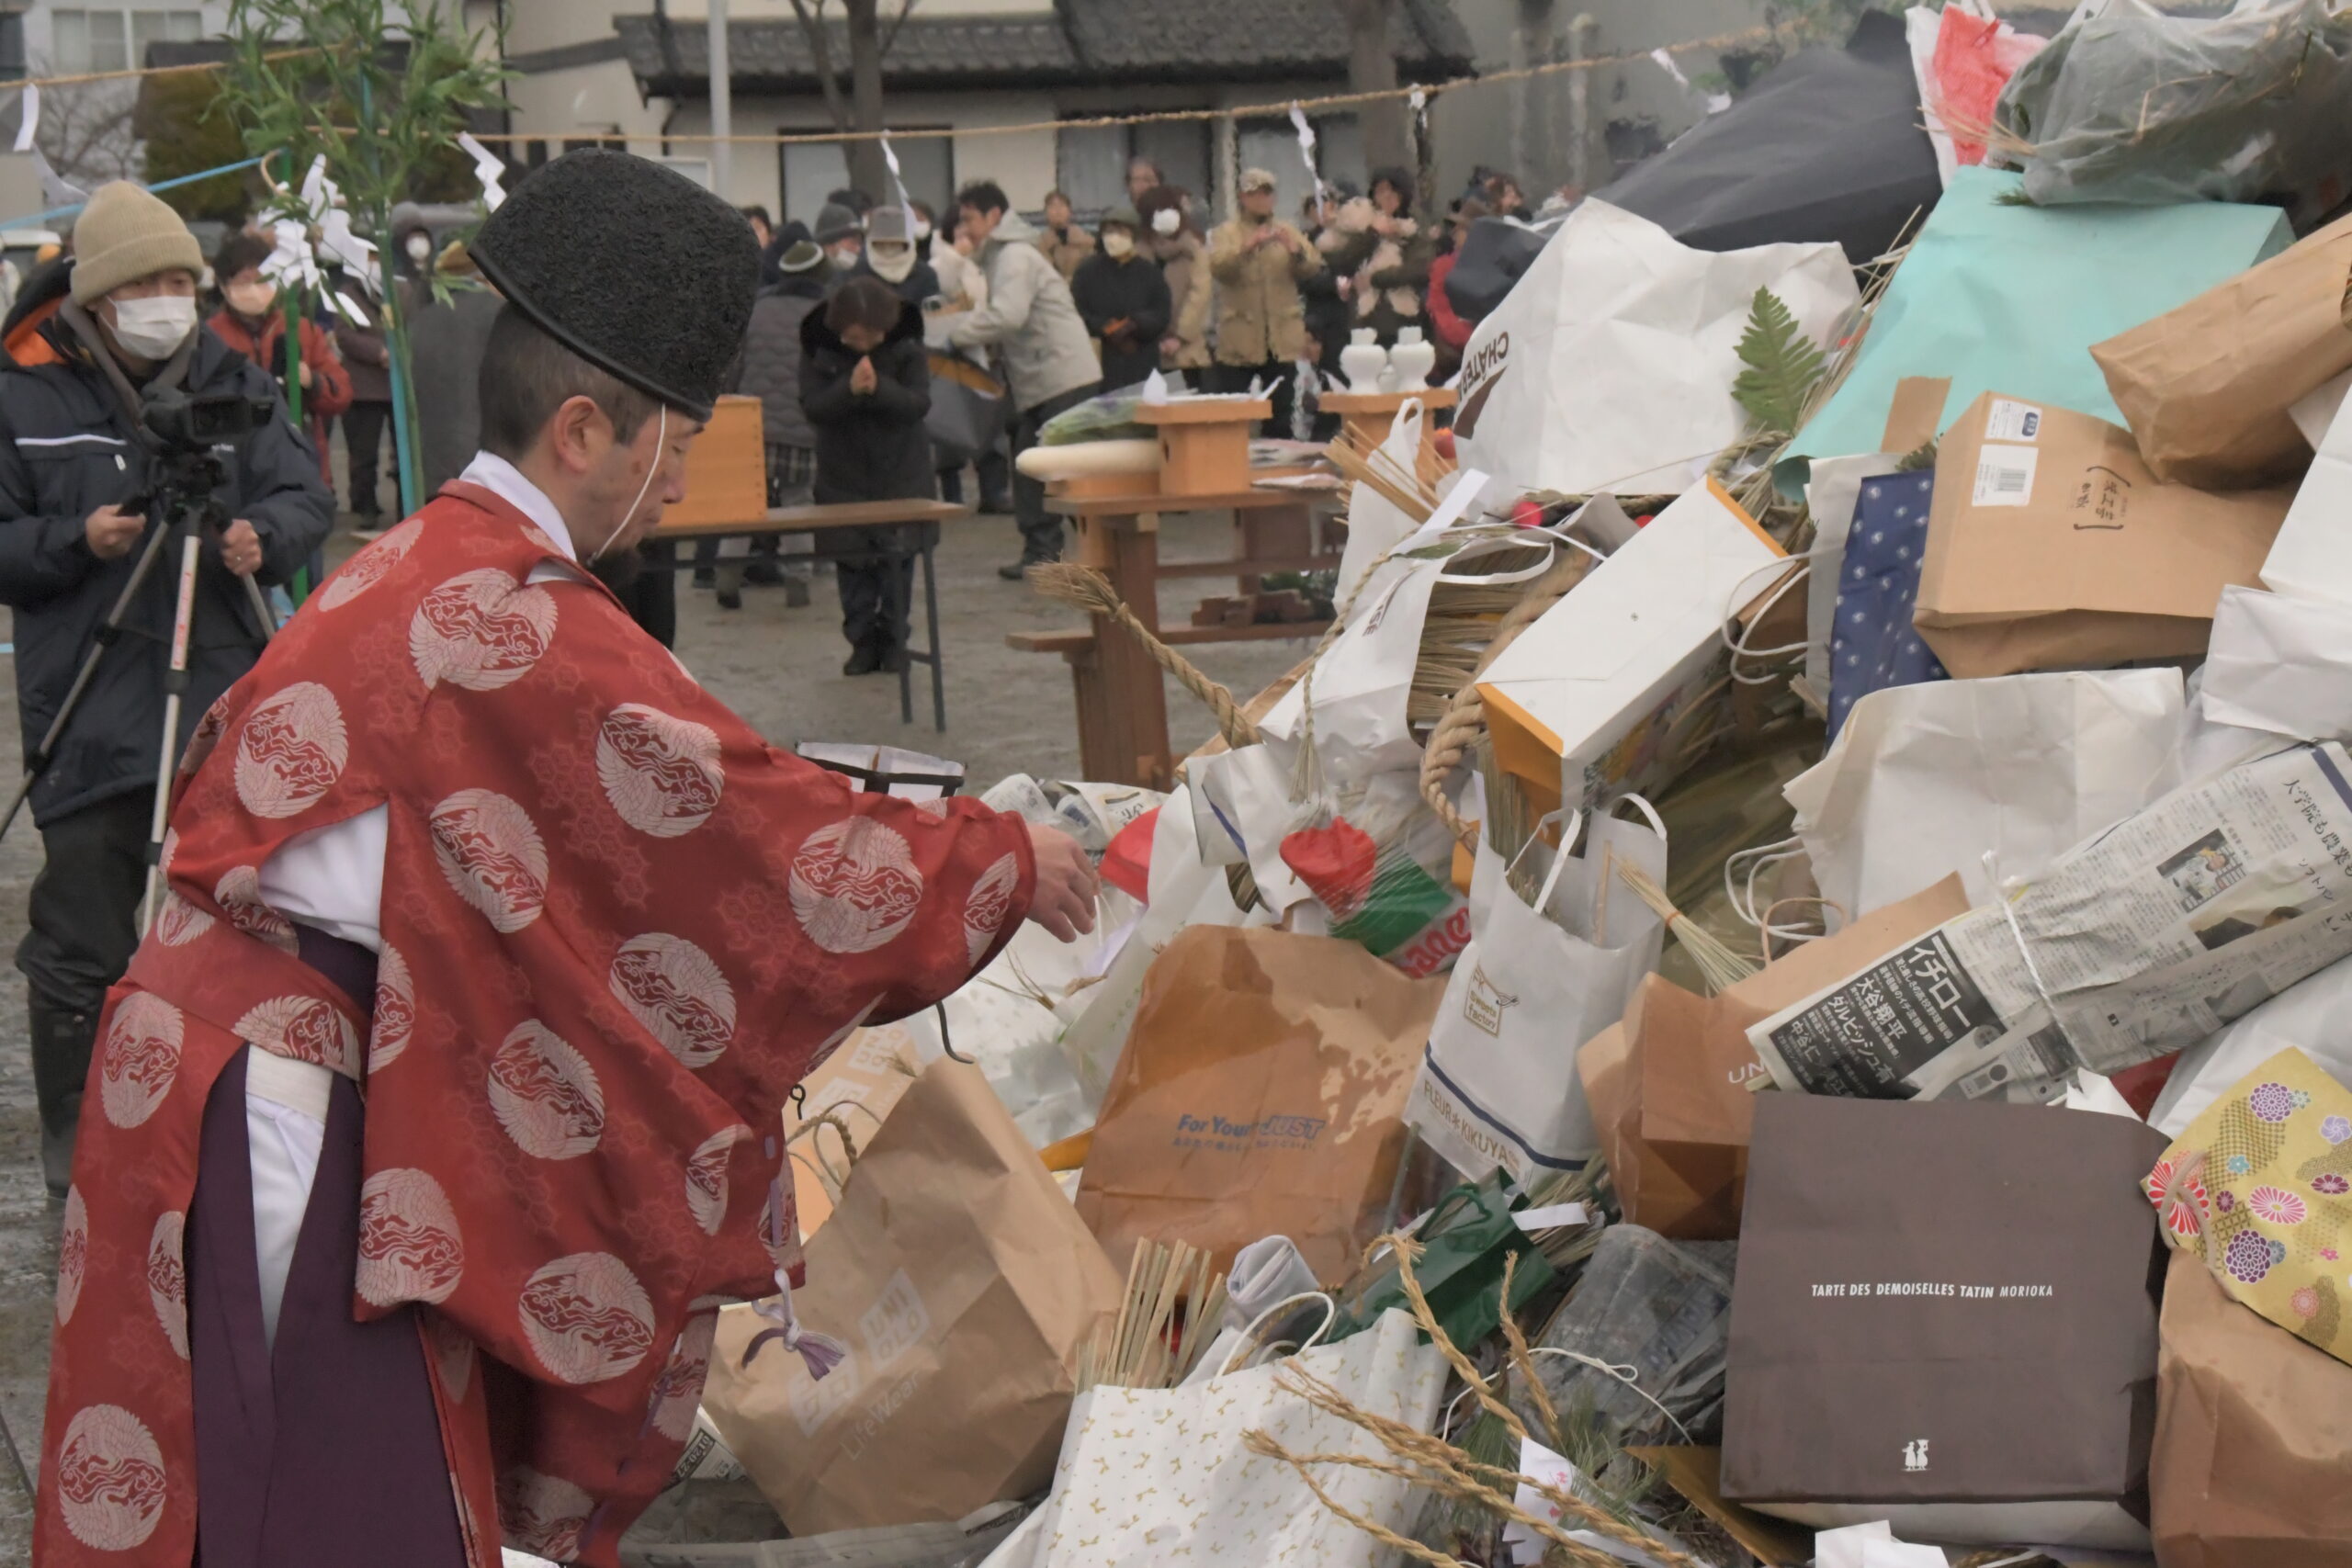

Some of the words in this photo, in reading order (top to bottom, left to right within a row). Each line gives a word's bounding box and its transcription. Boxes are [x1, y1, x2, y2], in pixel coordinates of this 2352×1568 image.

[1856, 976, 1908, 1041] 大谷翔平
[1908, 946, 1971, 1028] イチロー
[1827, 995, 1895, 1085] ダルビッシュ有
[1177, 1113, 1209, 1132] For
[1259, 1114, 1326, 1140] JUST
[1812, 1284, 1846, 1297] TARTE
[1849, 1283, 1871, 1296] DES
[1876, 1282, 1955, 1296] DEMOISELLES
[1960, 1285, 1995, 1298] TATIN
[1999, 1285, 2053, 1297] MORIOKA
[841, 1371, 921, 1461] LifeWear
